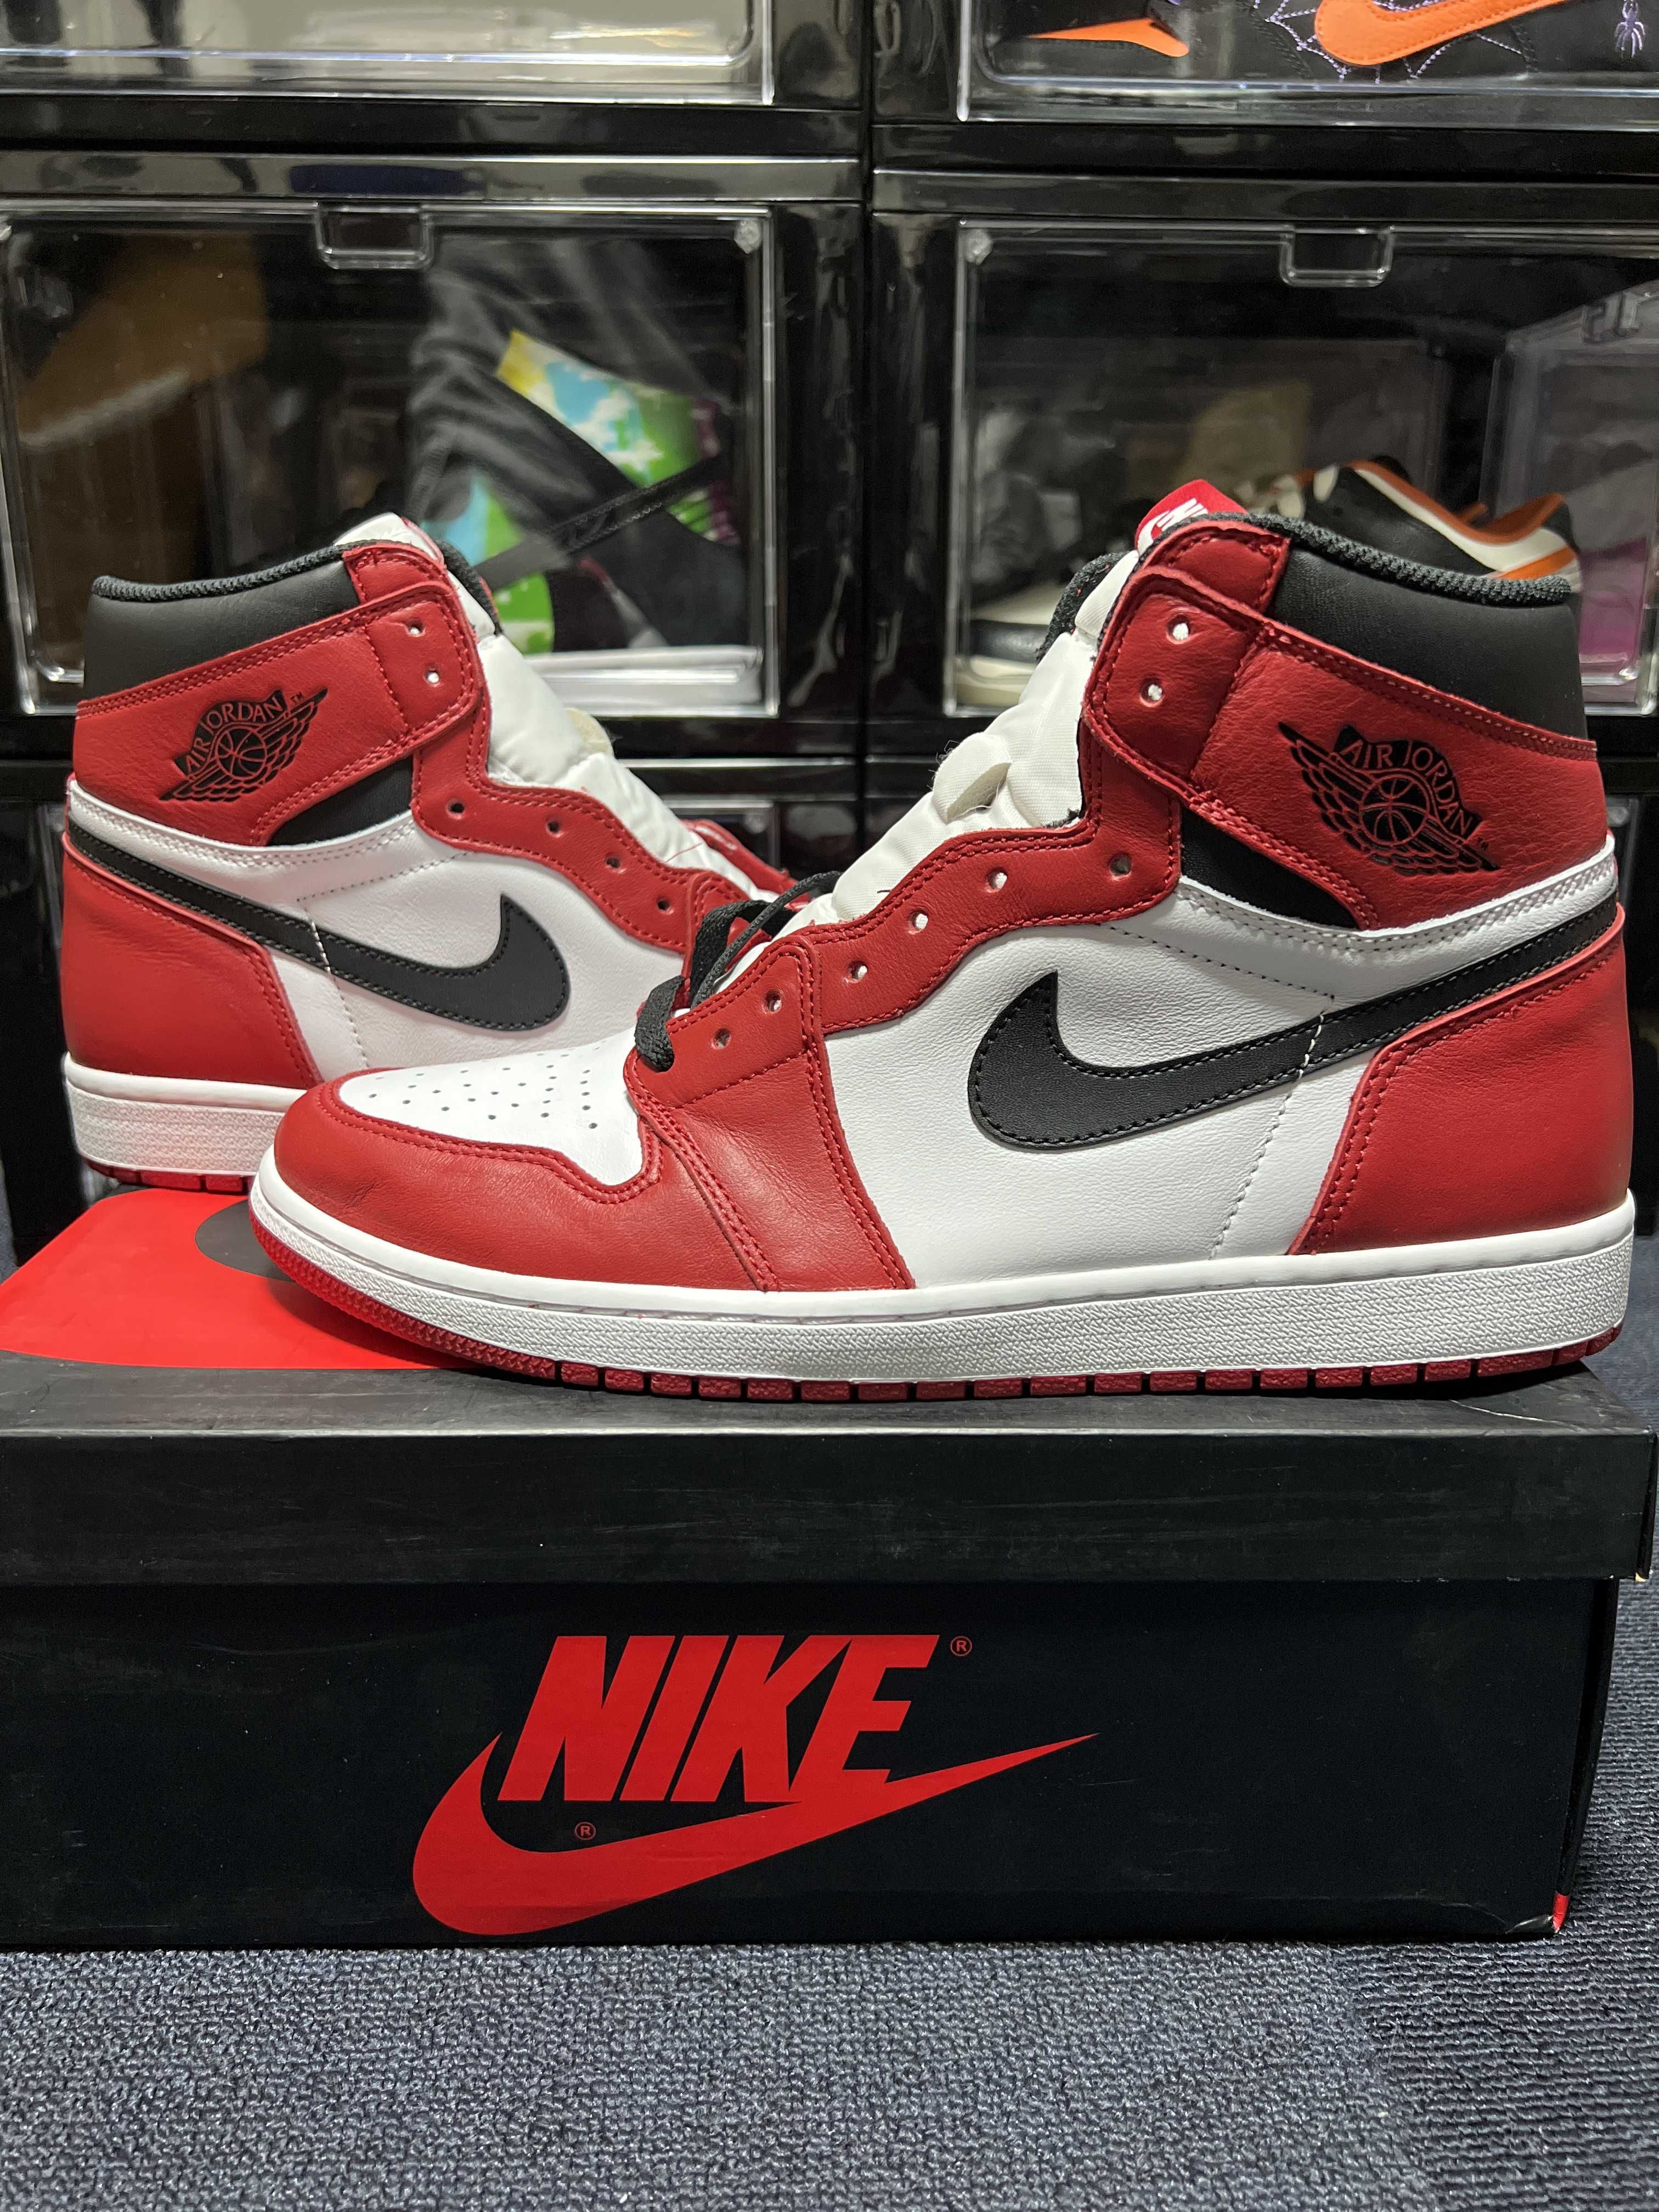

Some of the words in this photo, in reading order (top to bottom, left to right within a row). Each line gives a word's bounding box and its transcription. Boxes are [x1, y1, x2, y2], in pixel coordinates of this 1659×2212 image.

[185, 736, 212, 775] AIR
[199, 696, 284, 736] JORDAN
[1340, 739, 1393, 769] AIR
[1403, 739, 1475, 837] JORDAN
[498, 1634, 940, 1803] NIKE
